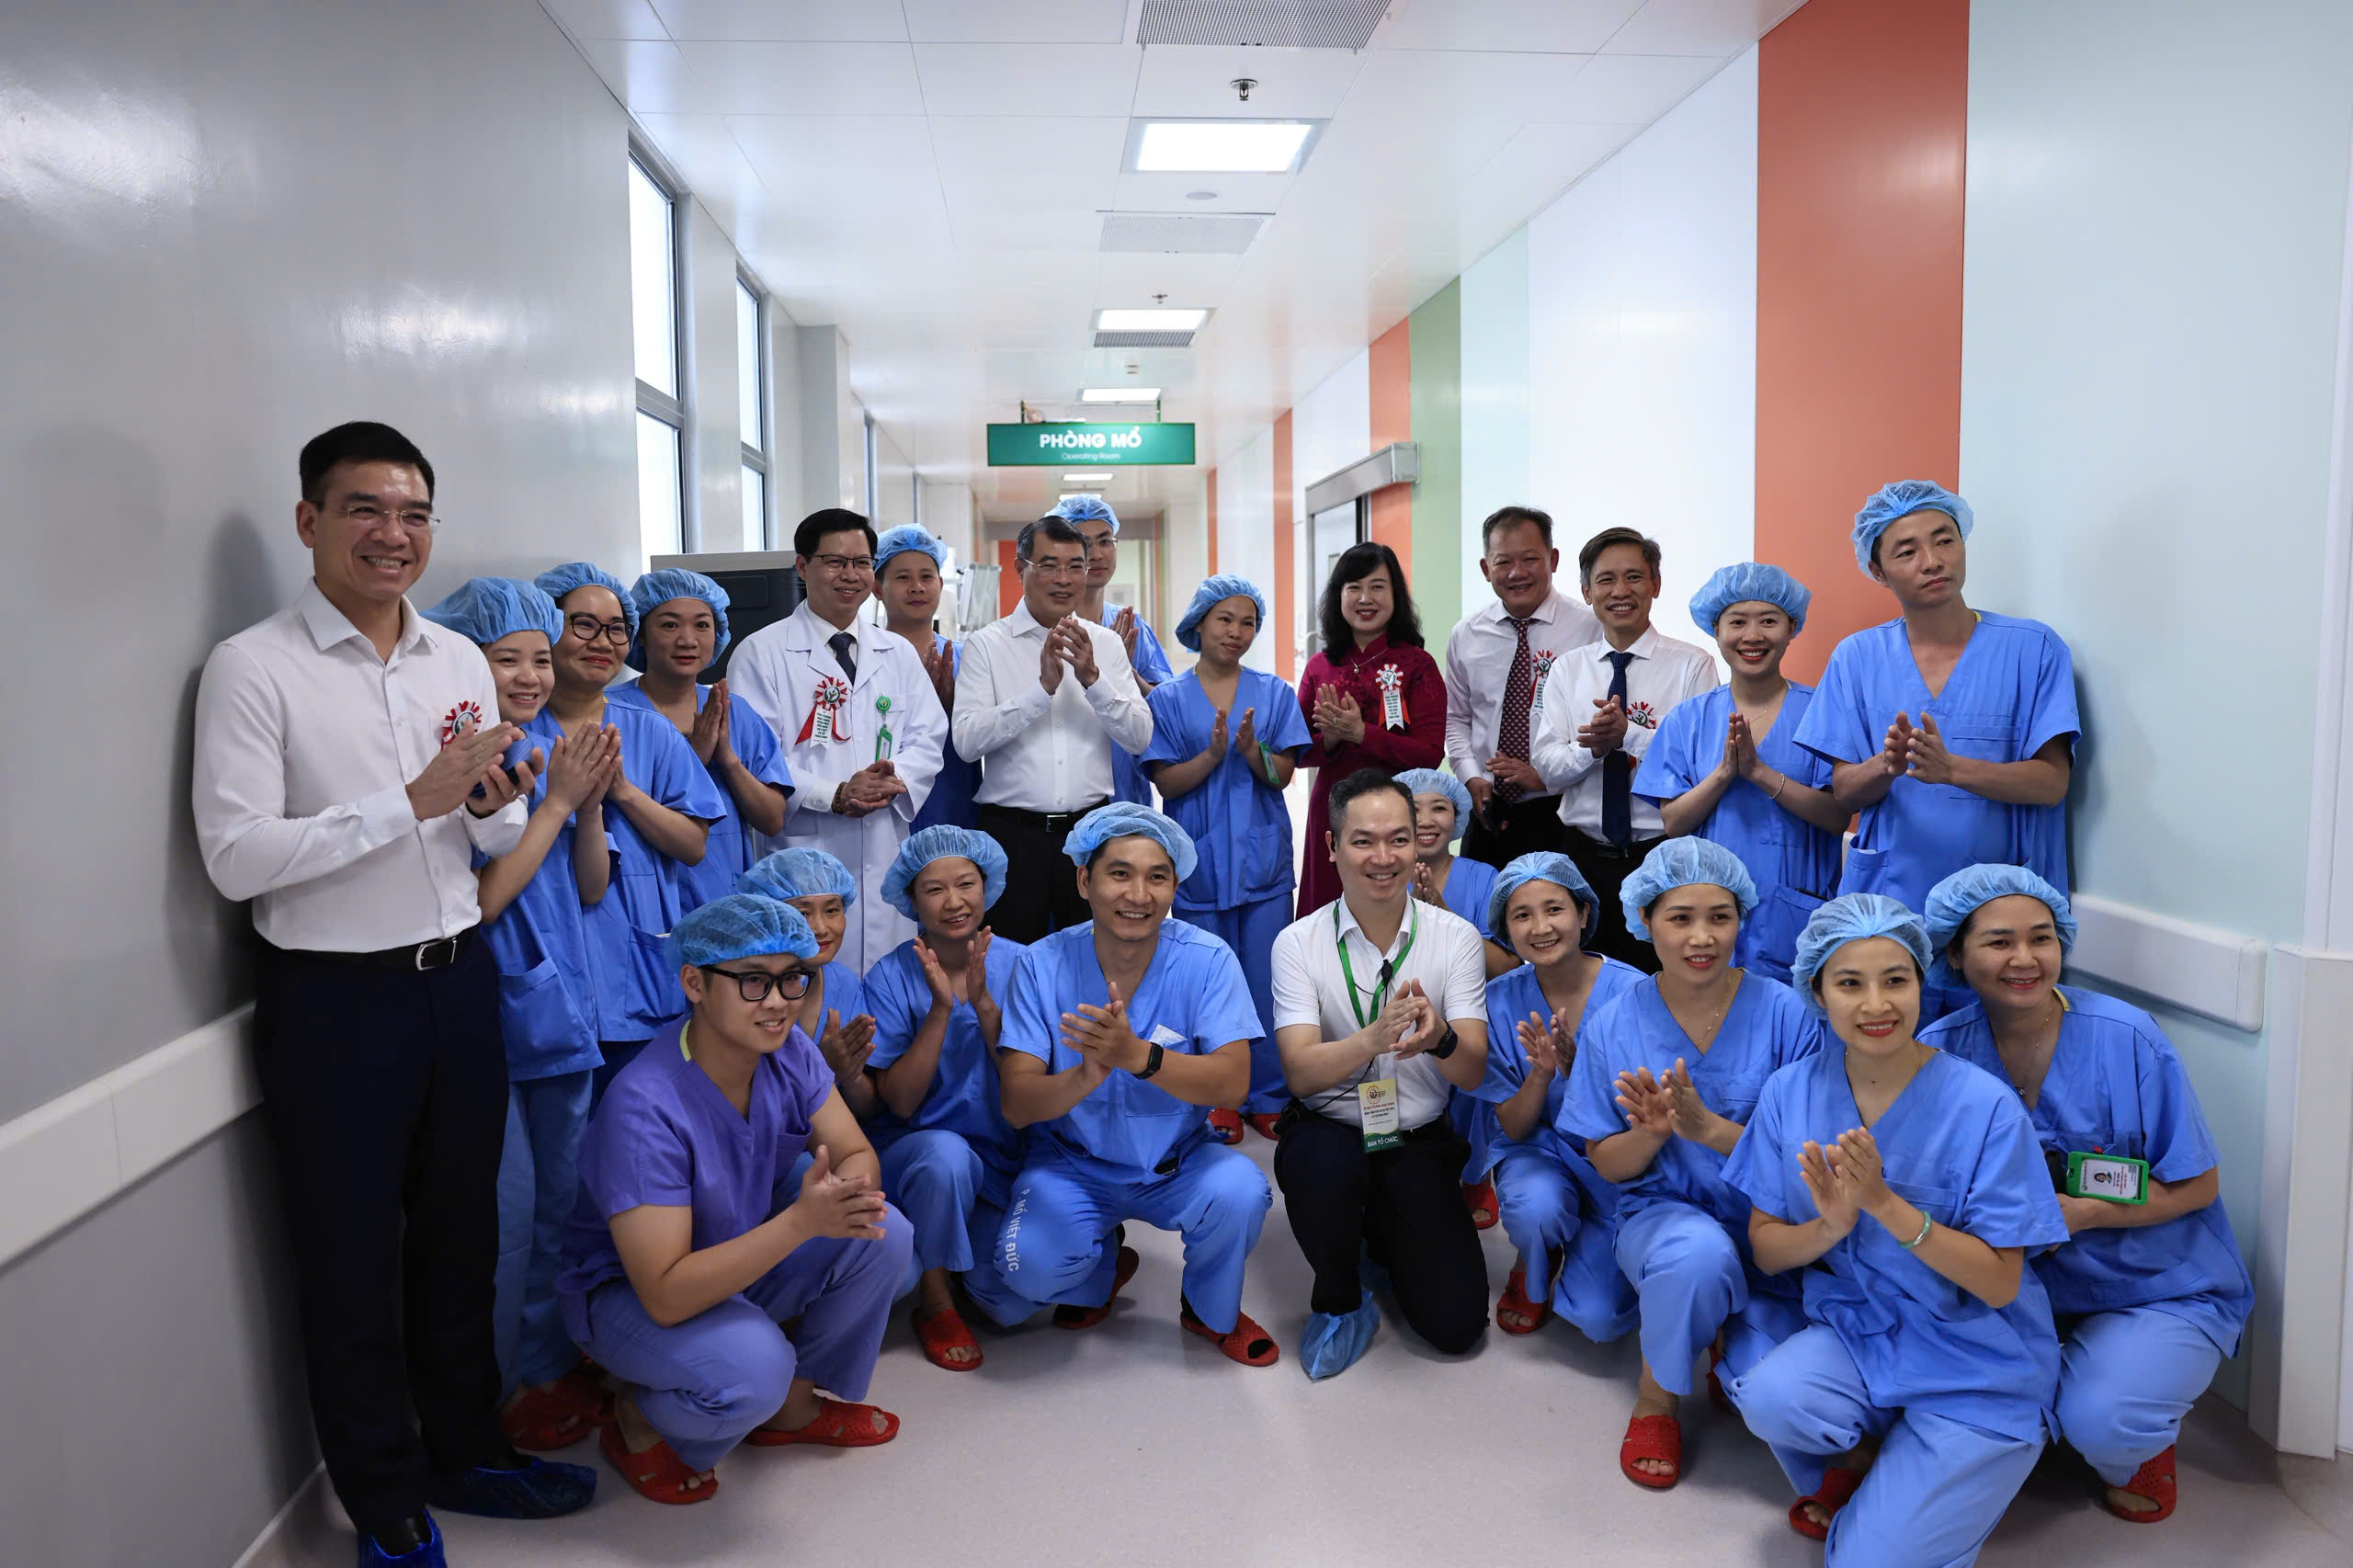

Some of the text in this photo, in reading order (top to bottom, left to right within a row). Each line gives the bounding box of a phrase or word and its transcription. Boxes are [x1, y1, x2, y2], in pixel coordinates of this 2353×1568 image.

[1039, 426, 1142, 449] PHÒNG MỔ
[1006, 1216, 1021, 1239] VIỆT
[1005, 1242, 1020, 1272] ĐỨC
